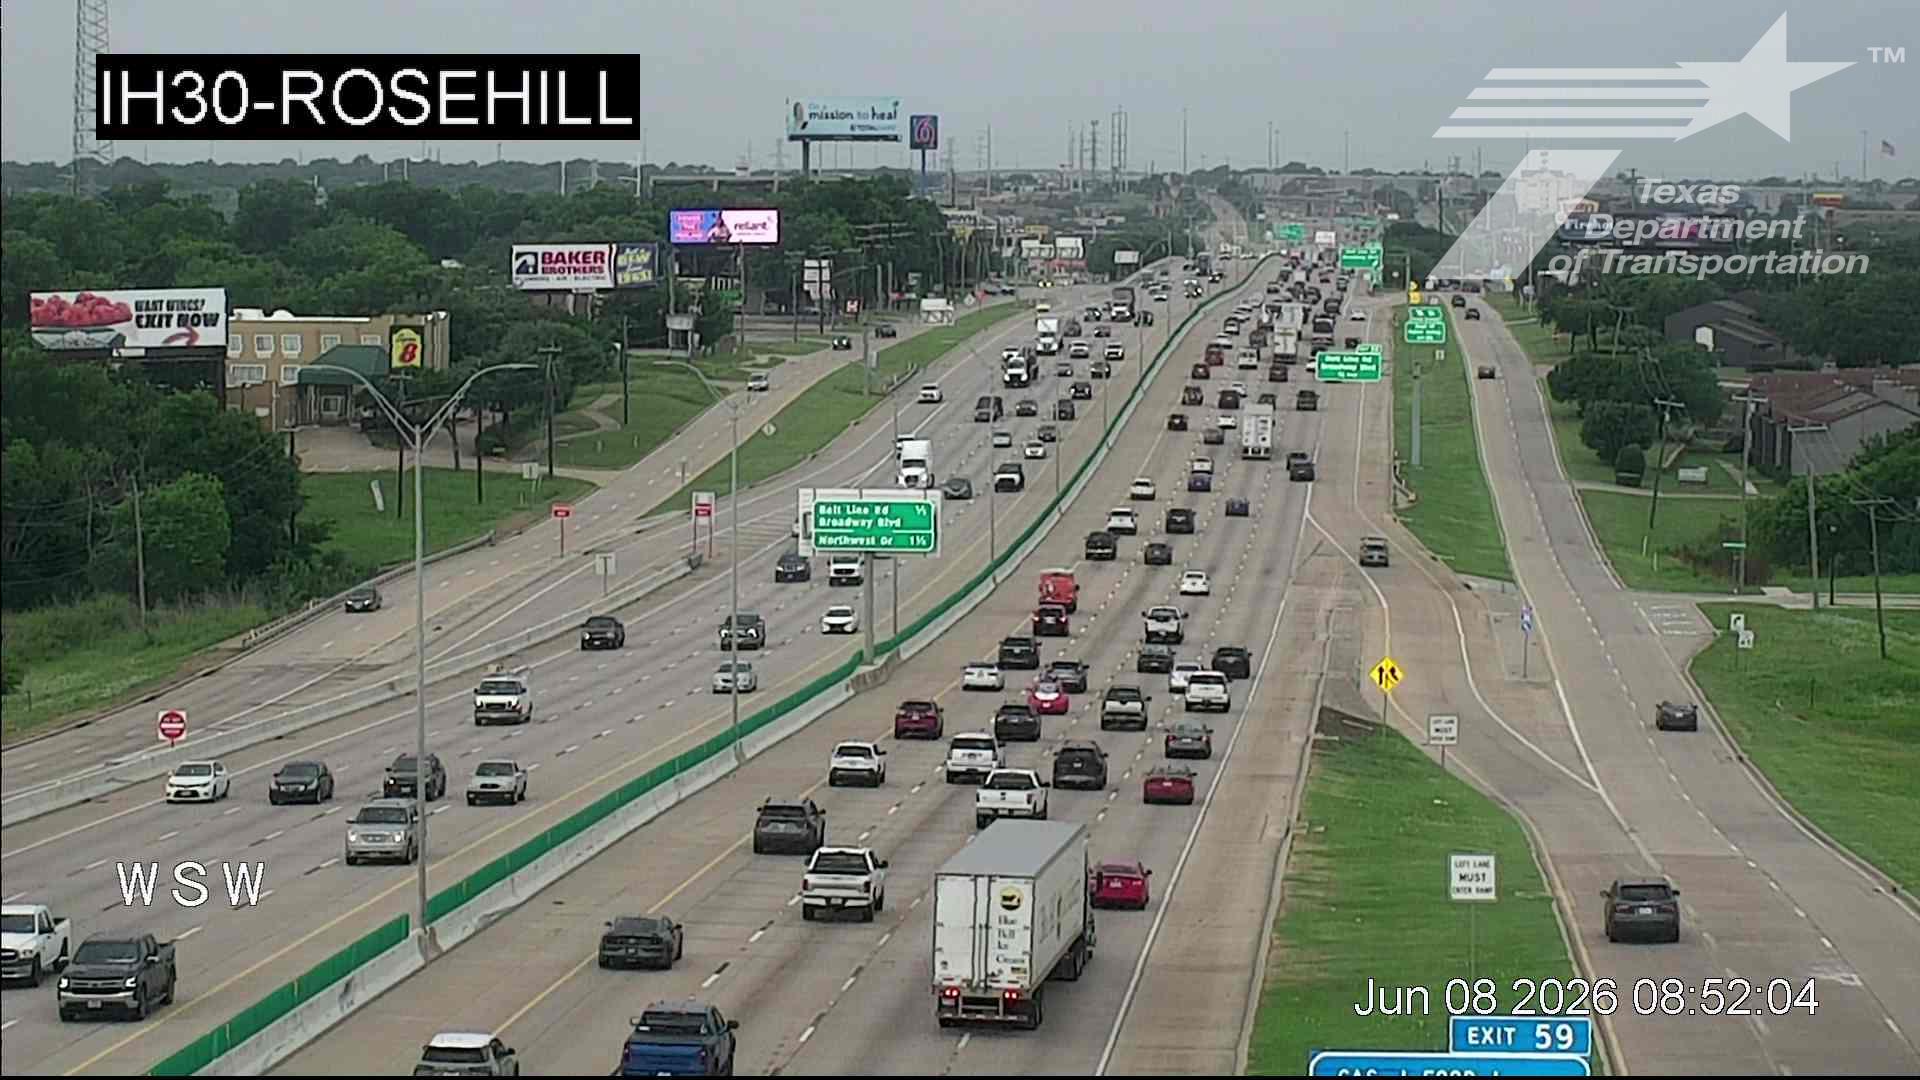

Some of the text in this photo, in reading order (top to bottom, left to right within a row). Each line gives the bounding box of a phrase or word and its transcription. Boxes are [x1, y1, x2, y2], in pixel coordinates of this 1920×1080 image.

[808, 109, 853, 120] mission
[871, 103, 897, 120] heal
[541, 251, 606, 265] BAKER
[541, 265, 604, 275] BROTHERS
[134, 300, 164, 312] WANT
[135, 312, 220, 328] EXIT NOW
[399, 342, 417, 363] 8
[818, 505, 841, 514] Belt
[846, 505, 869, 514] Line
[874, 505, 889, 514] Rd
[819, 517, 902, 528] Broadway Blvd
[819, 535, 876, 546] Northwest
[880, 536, 893, 545] Dr
[1458, 872, 1486, 882] MUST
[1467, 1023, 1574, 1050] EXIT 59
